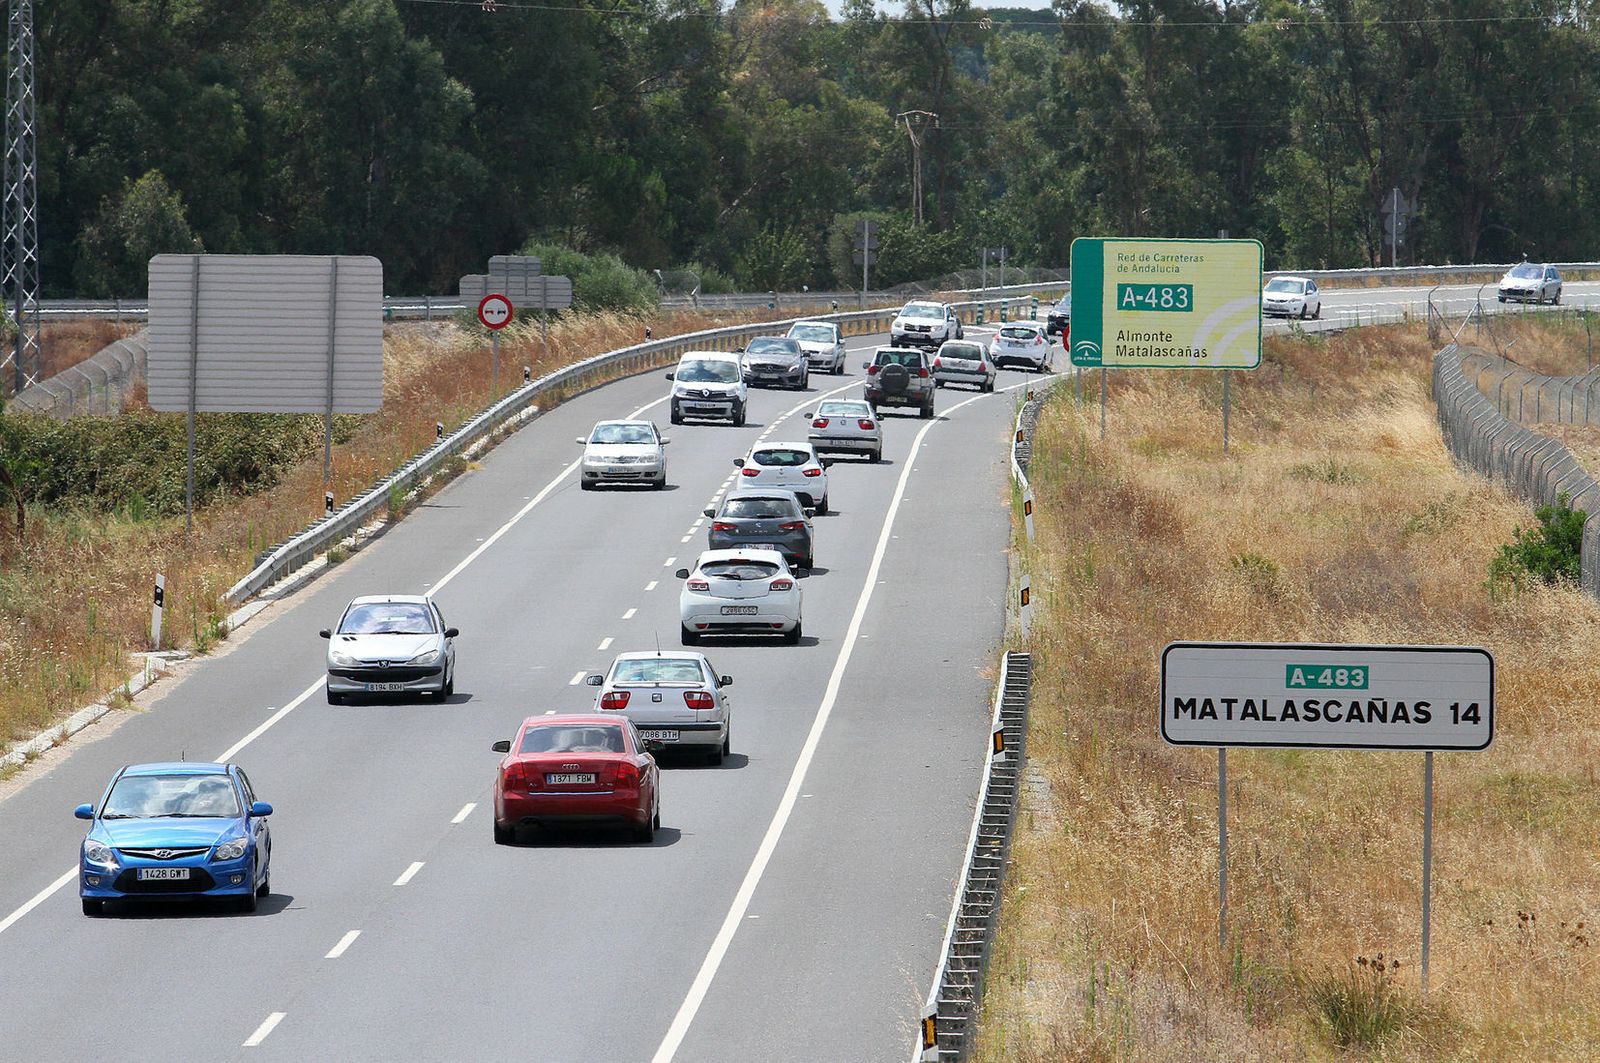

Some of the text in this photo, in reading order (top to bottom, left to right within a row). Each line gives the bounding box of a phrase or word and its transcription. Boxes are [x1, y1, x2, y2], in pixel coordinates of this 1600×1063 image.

[1117, 253, 1204, 263] Red de Carreteras
[1117, 264, 1129, 273] de
[1122, 287, 1188, 308] A-483
[1116, 330, 1173, 342] Almonte
[1116, 345, 1208, 358] Matalascañas
[1289, 668, 1365, 687] A-483
[1173, 697, 1481, 725] MATALASCAÑAS 14
[640, 730, 678, 738] 7086 BTH
[553, 774, 592, 783] 1371 FBW
[145, 869, 187, 879] 1428 GWT
